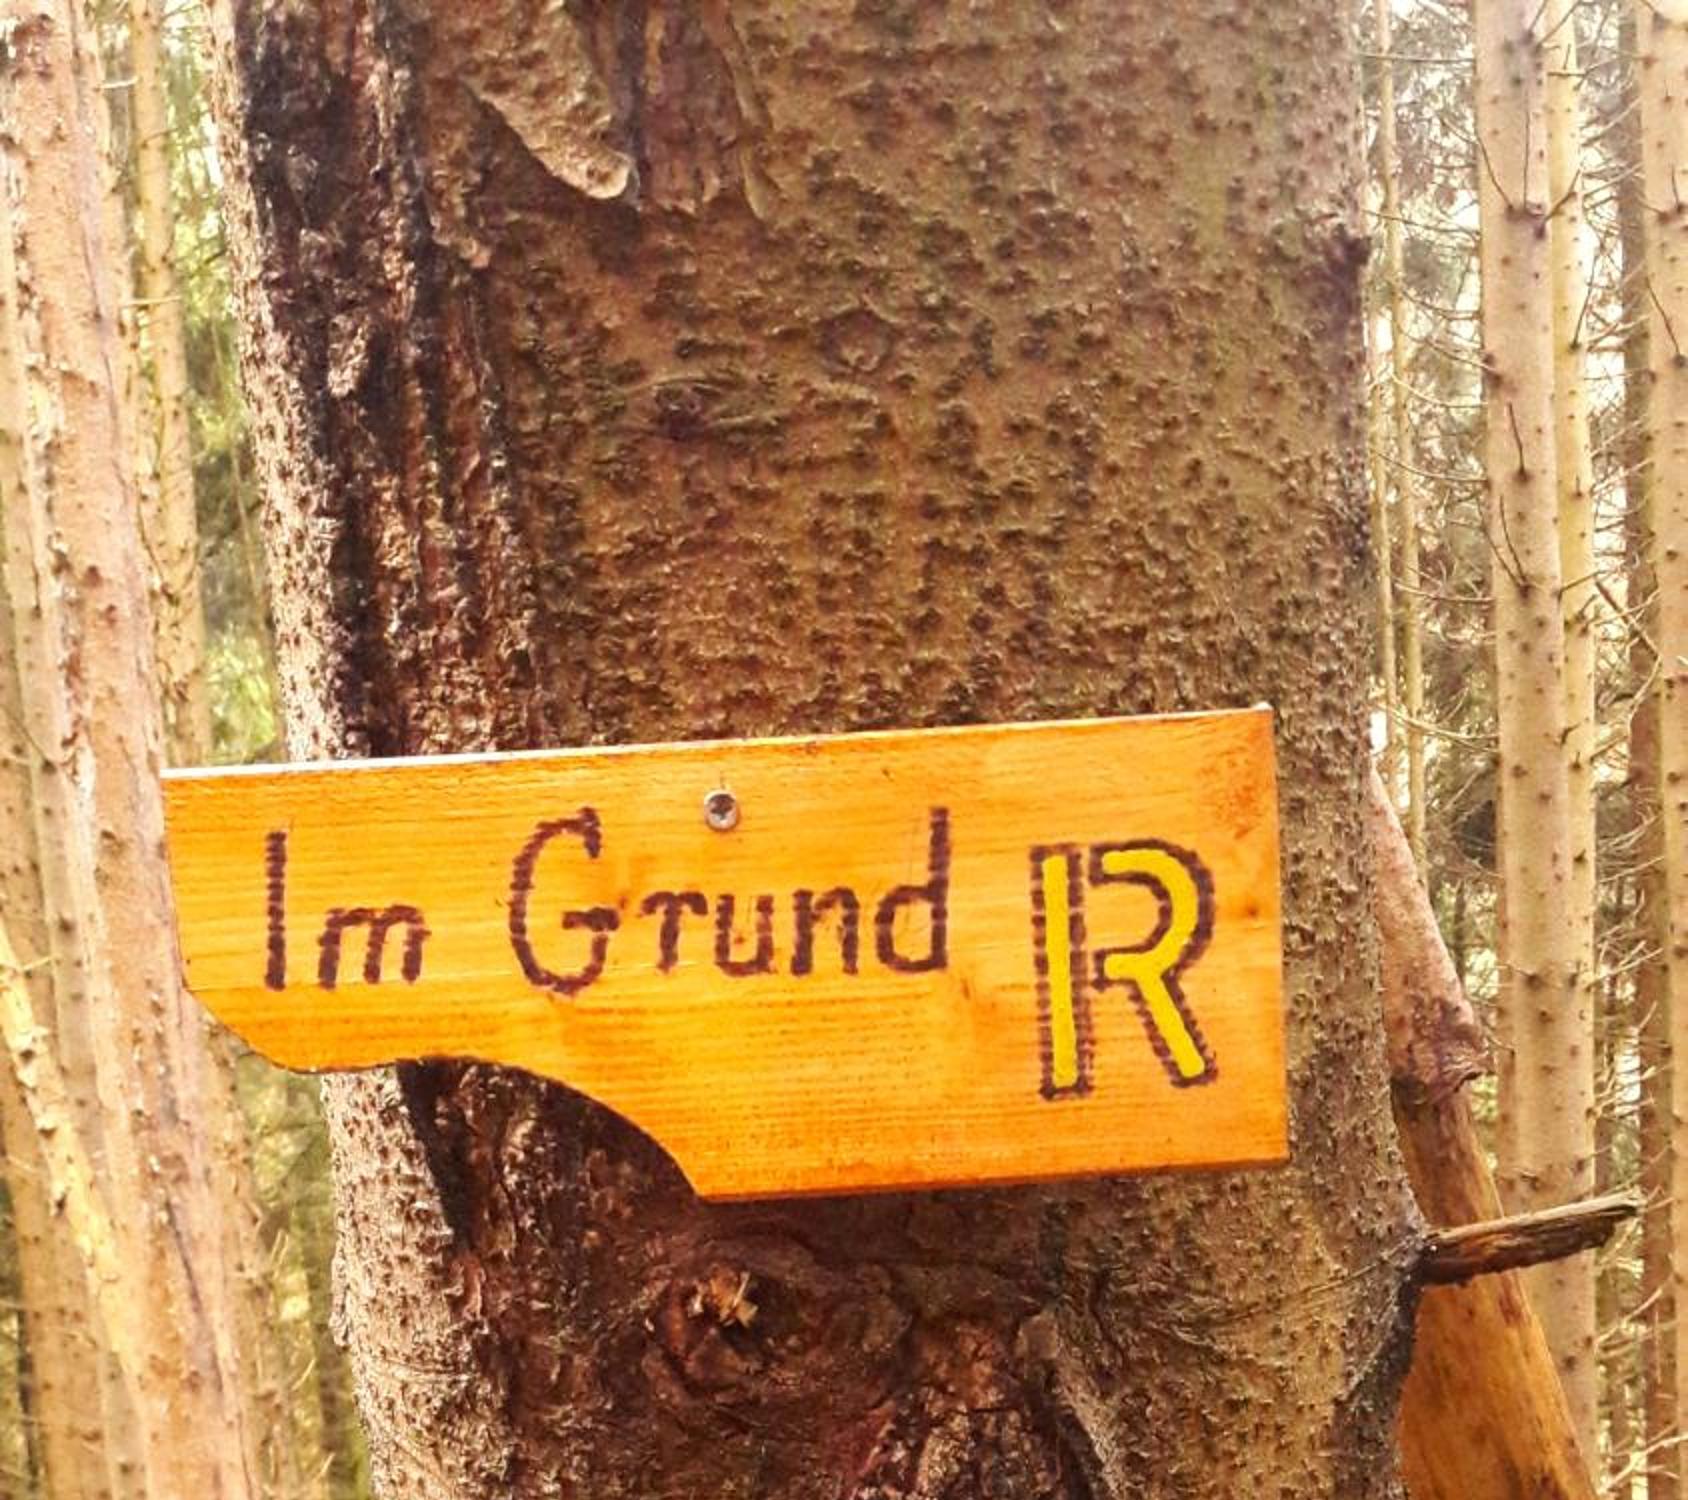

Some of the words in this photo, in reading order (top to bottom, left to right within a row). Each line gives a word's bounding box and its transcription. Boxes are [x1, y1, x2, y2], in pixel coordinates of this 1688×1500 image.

[264, 829, 431, 991] Im
[509, 806, 951, 997] Grund
[1030, 838, 1219, 1100] R
